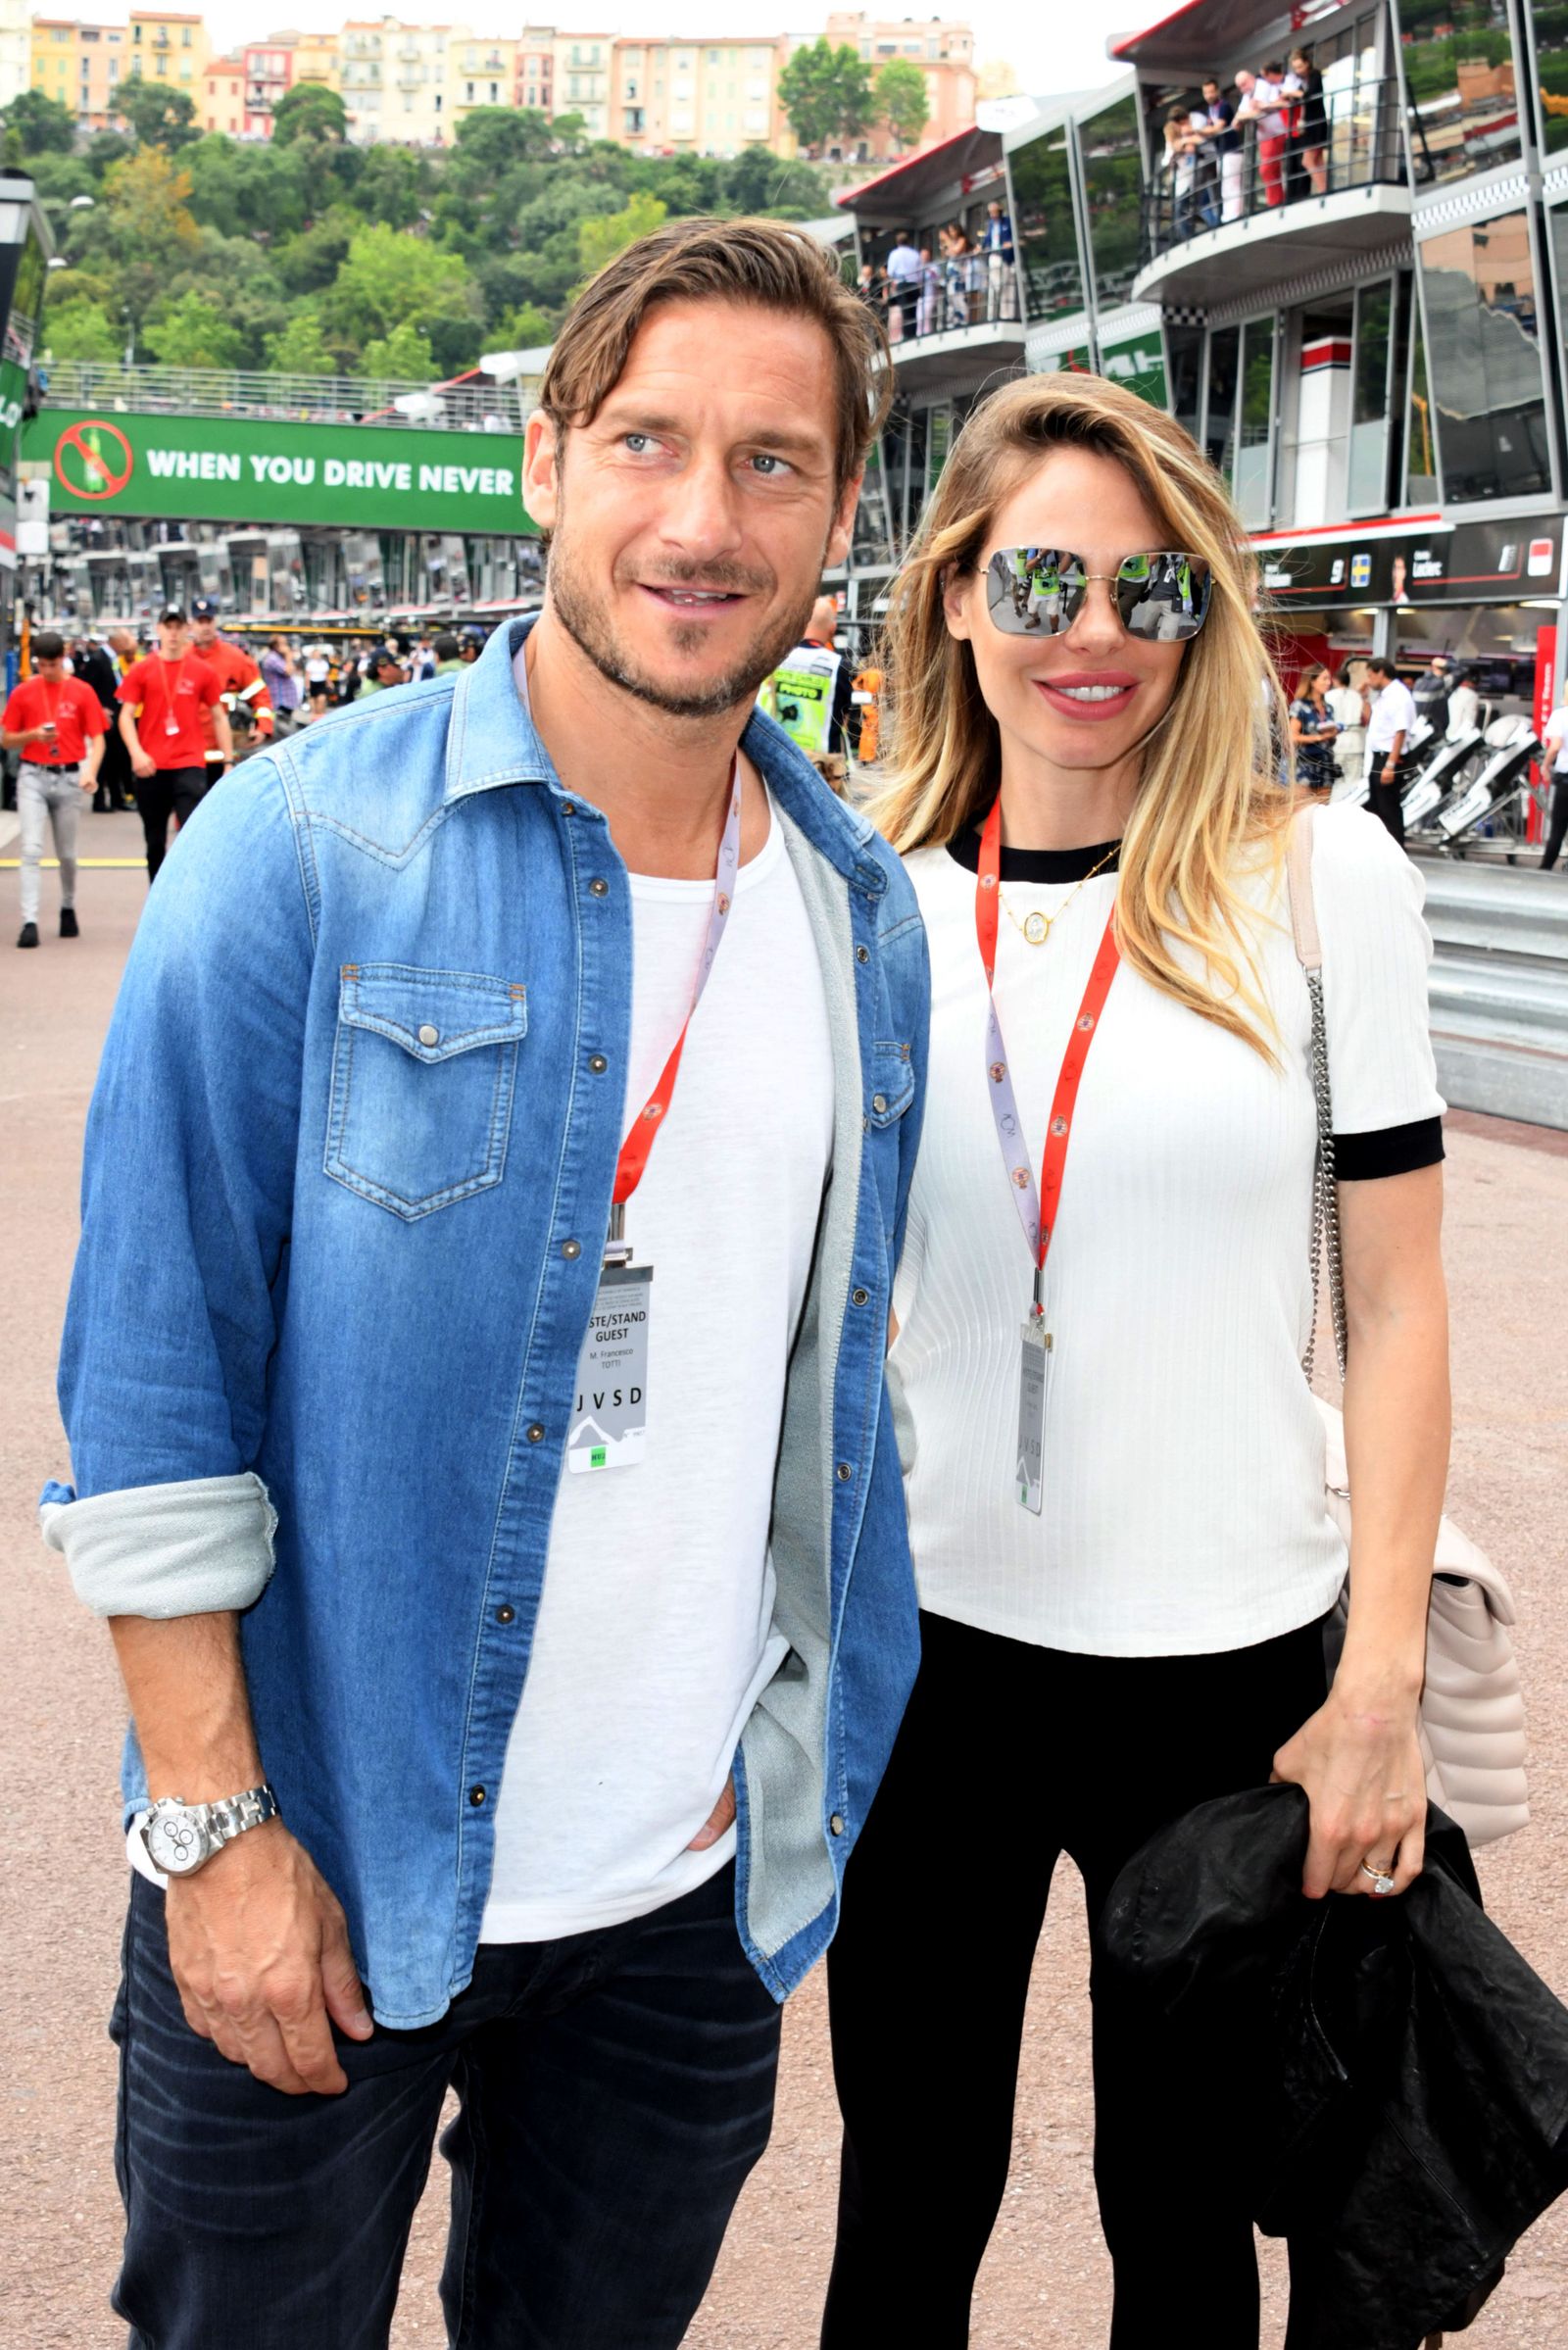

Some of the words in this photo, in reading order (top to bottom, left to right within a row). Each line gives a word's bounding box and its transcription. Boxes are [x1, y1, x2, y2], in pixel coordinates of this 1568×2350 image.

[147, 450, 240, 480] WHEN
[250, 455, 315, 484] YOU
[324, 460, 412, 490] DRIVE
[418, 465, 514, 496] NEVER
[589, 1311, 647, 1328] STE/STAND
[596, 1328, 629, 1342] GUEST
[600, 1347, 634, 1358] Francesco
[602, 1359, 621, 1369] TOTTI
[593, 1392, 606, 1410] V
[612, 1390, 622, 1407] S
[630, 1387, 642, 1404] D
